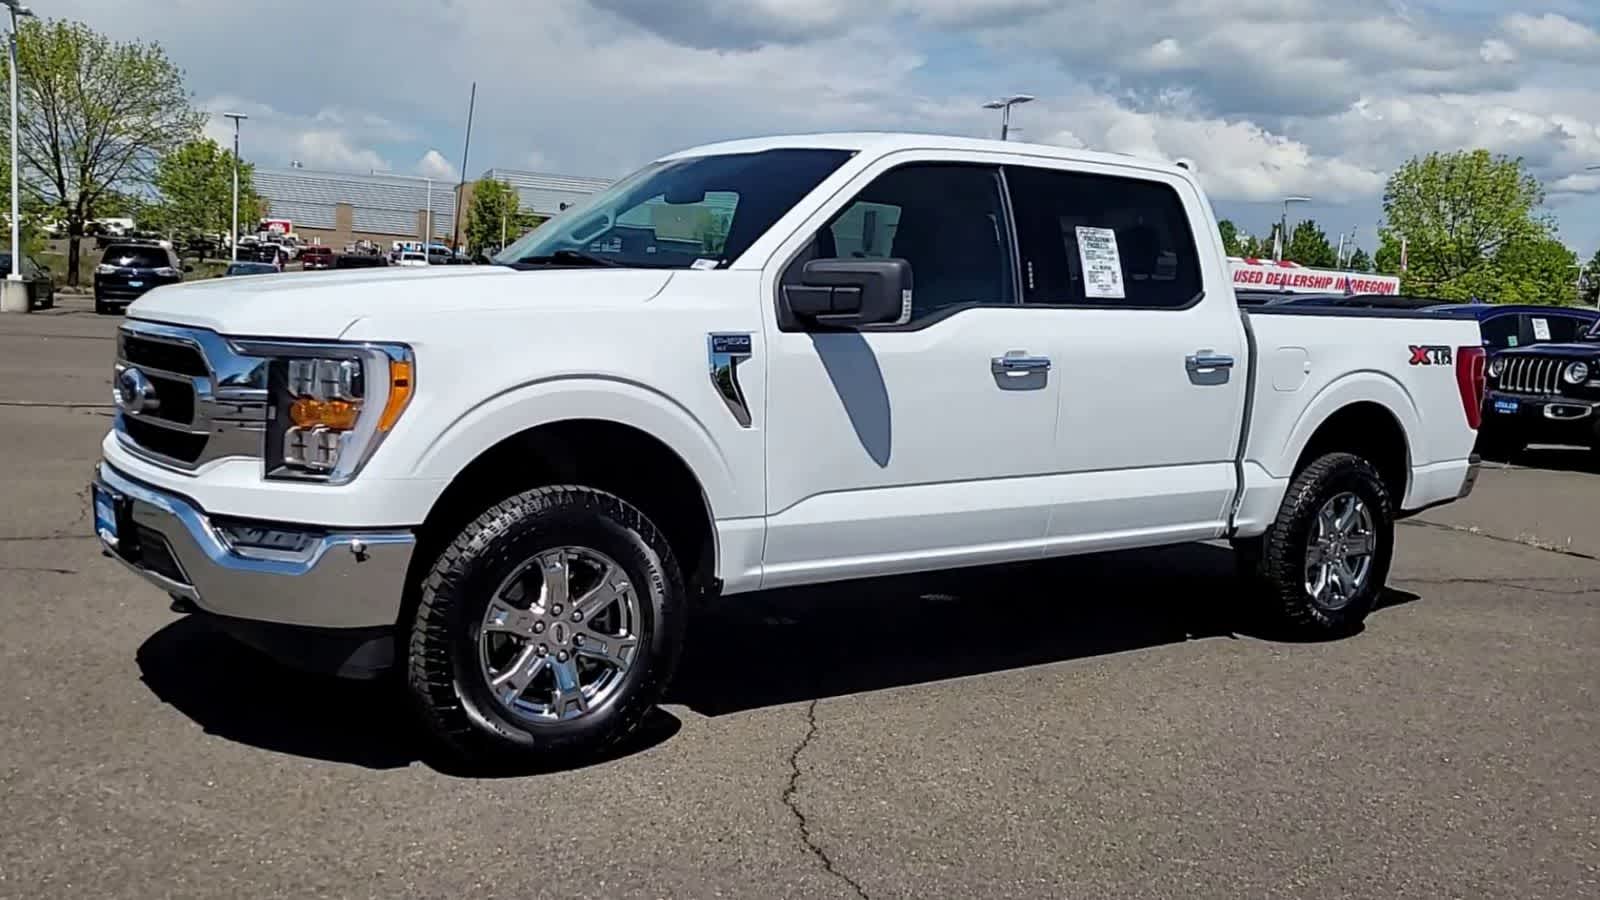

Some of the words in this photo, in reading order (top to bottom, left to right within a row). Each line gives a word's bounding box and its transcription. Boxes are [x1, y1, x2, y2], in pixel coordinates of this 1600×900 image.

[1233, 268, 1263, 284] USED
[1265, 271, 1334, 290] DEALERSHIP
[1408, 344, 1452, 366] XTR
